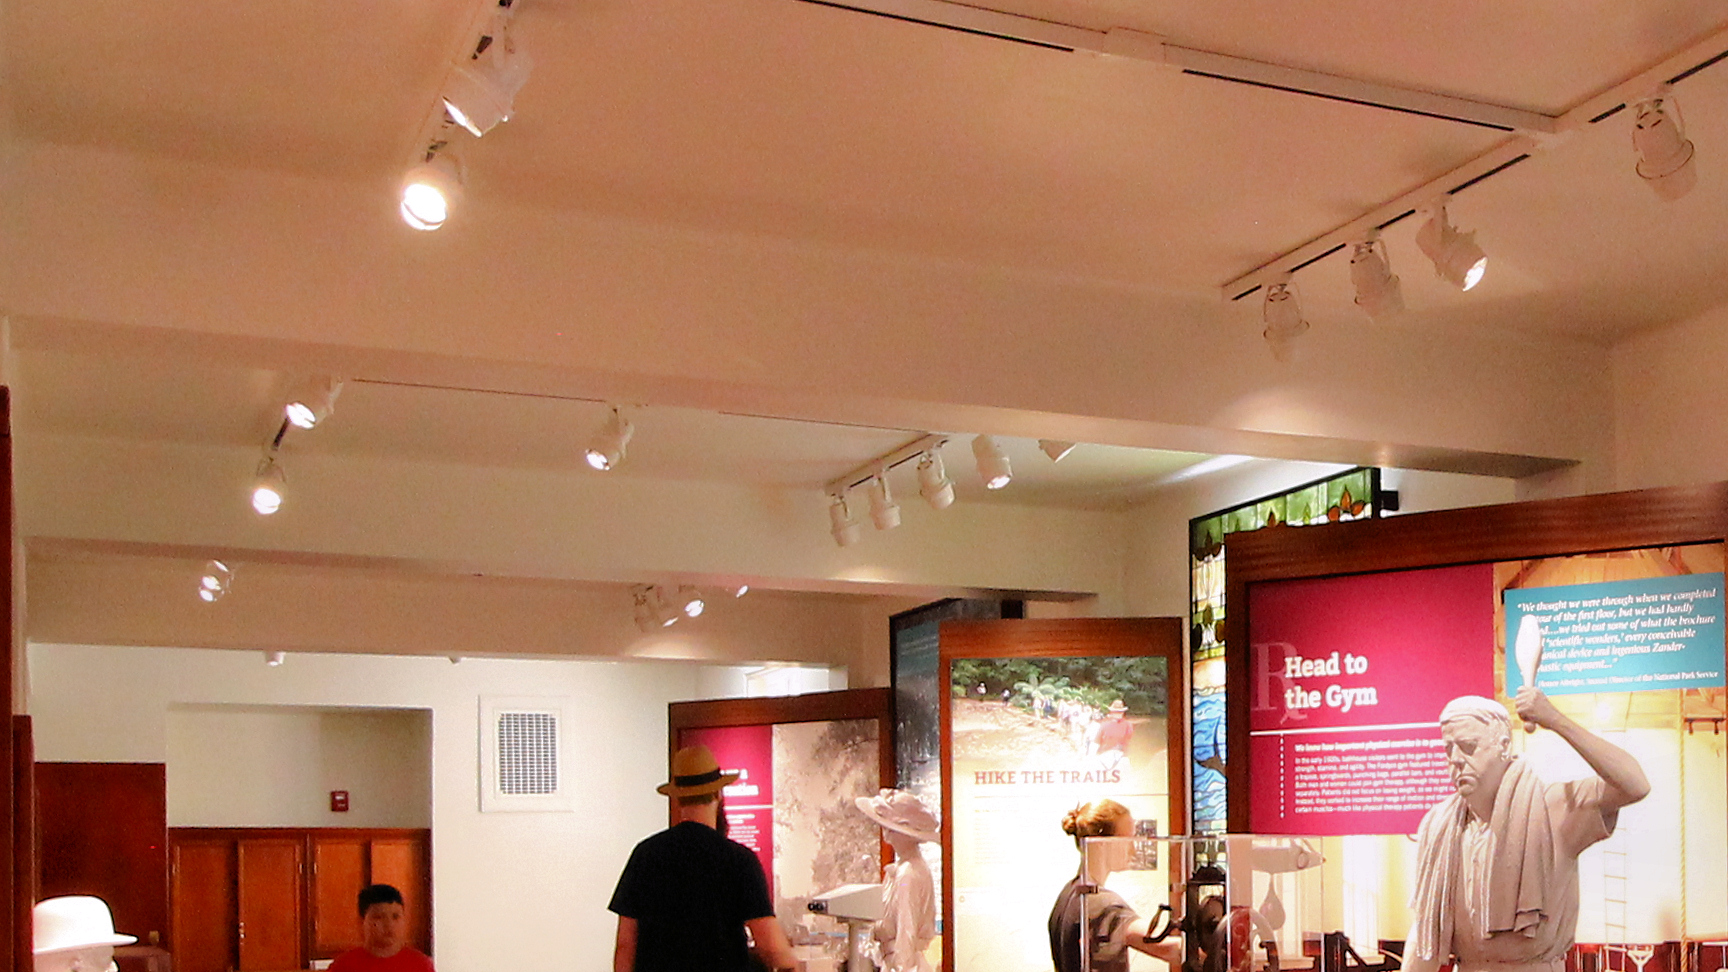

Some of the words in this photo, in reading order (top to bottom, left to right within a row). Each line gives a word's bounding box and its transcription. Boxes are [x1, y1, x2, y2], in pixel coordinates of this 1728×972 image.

[1536, 601, 1566, 612] thought
[1602, 596, 1633, 607] through
[1636, 595, 1658, 603] when
[1674, 590, 1716, 602] completed
[1553, 613, 1563, 624] of
[1578, 612, 1594, 622] first
[1596, 611, 1616, 621] floor,
[1619, 609, 1632, 617] but
[1649, 607, 1664, 615] had
[1667, 605, 1694, 615] hardly
[1285, 651, 1341, 678] Head
[1344, 653, 1368, 674] to
[1284, 685, 1322, 709] the
[1325, 684, 1378, 712] Gym
[974, 771, 1016, 785] HIKE
[1021, 770, 1055, 784] THE
[1060, 770, 1121, 783] TRAILS
